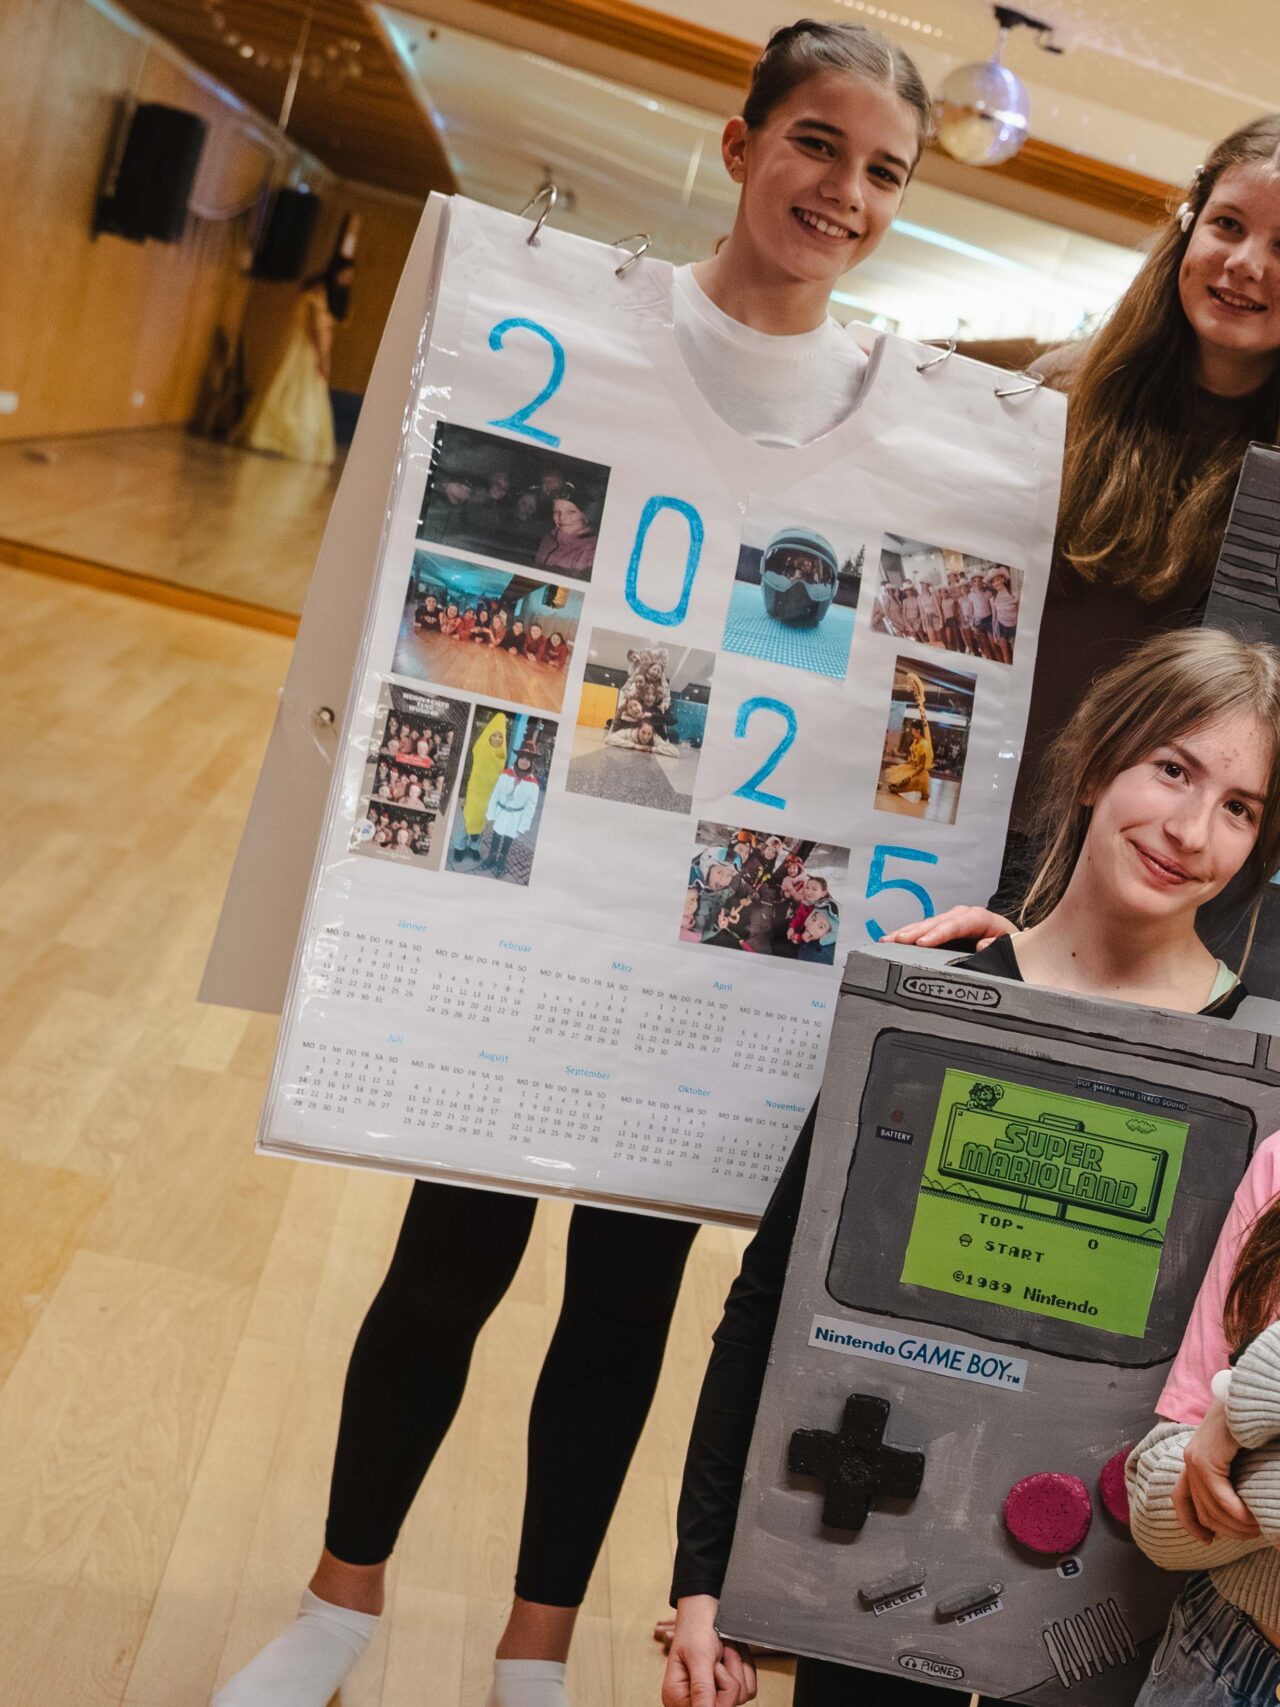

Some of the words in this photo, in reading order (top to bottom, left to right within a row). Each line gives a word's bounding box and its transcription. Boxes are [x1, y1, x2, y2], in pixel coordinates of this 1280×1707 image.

[487, 317, 566, 447] 2
[625, 495, 705, 627] 0
[734, 696, 798, 811] 2
[865, 844, 938, 942] 5
[499, 939, 532, 953] Februar
[612, 961, 633, 973] März
[713, 981, 733, 992] April
[919, 983, 944, 996] OFF
[956, 988, 978, 1000] ON
[811, 1000, 826, 1010] Mai
[479, 1050, 509, 1063] August
[565, 1065, 610, 1080] September
[678, 1085, 711, 1097] Oktober
[765, 1100, 806, 1114] November
[880, 1129, 911, 1142] BATTERY
[994, 1122, 1104, 1172] SUPER
[979, 1213, 1024, 1231] TOP-
[984, 1240, 1045, 1263] START
[1023, 1286, 1099, 1316] Nintendo
[815, 1326, 895, 1356] Nintendo
[898, 1340, 966, 1371] GAME
[966, 1354, 1013, 1380] BOY
[1060, 1558, 1080, 1577] B
[875, 1588, 925, 1613] SELECT
[956, 1600, 1001, 1624] START
[920, 1661, 960, 1678] PHONES
